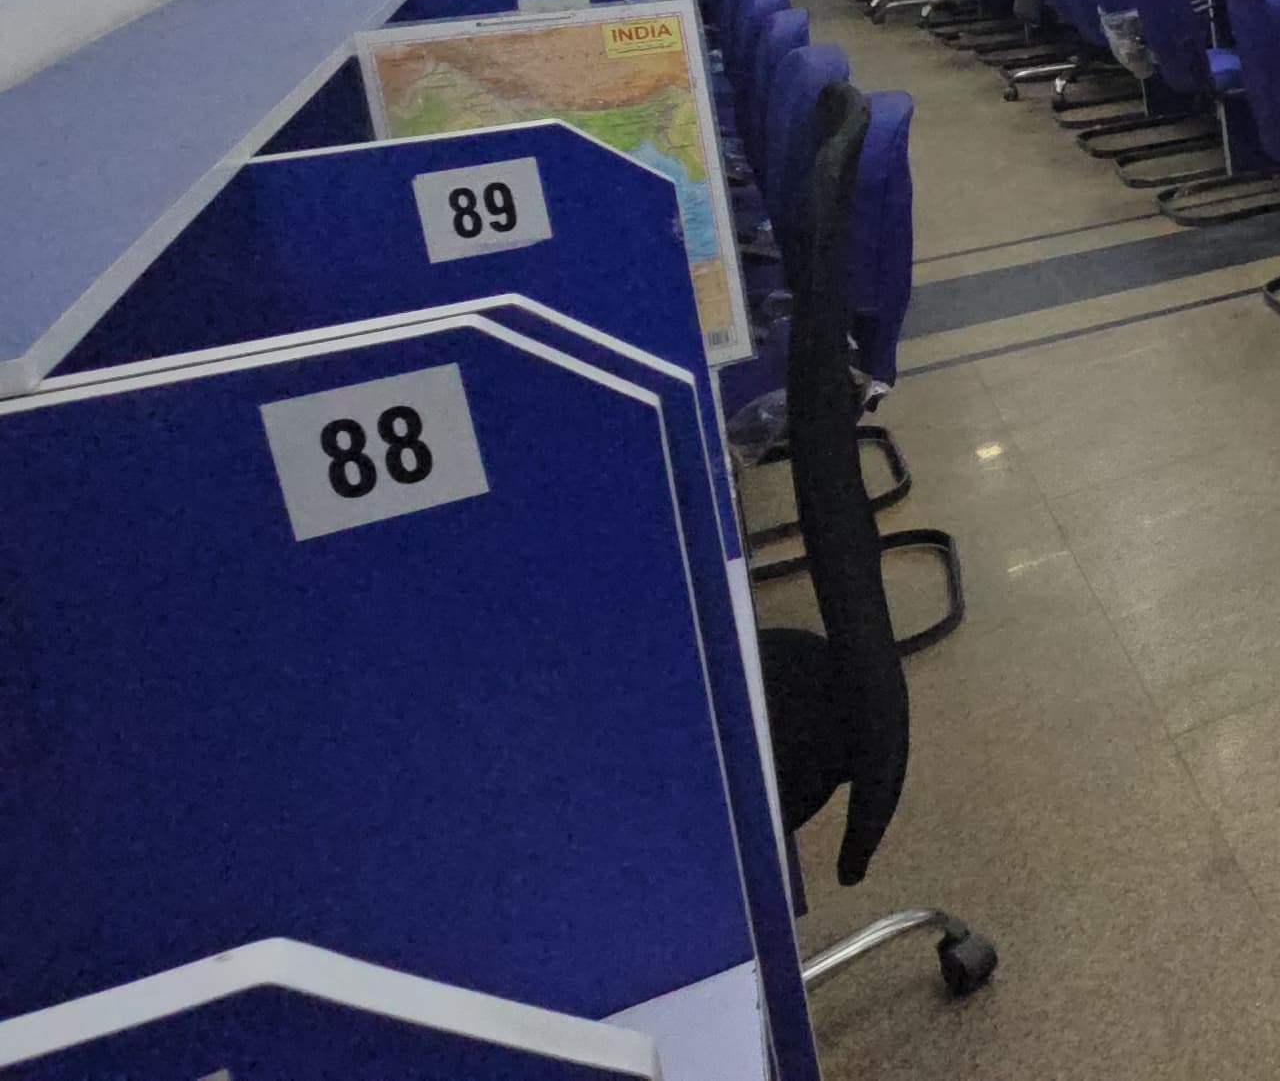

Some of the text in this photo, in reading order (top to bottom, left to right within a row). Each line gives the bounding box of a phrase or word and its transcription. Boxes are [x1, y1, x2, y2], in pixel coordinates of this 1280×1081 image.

[611, 23, 673, 45] INDIA
[448, 182, 517, 239] 89
[319, 405, 433, 500] 88
